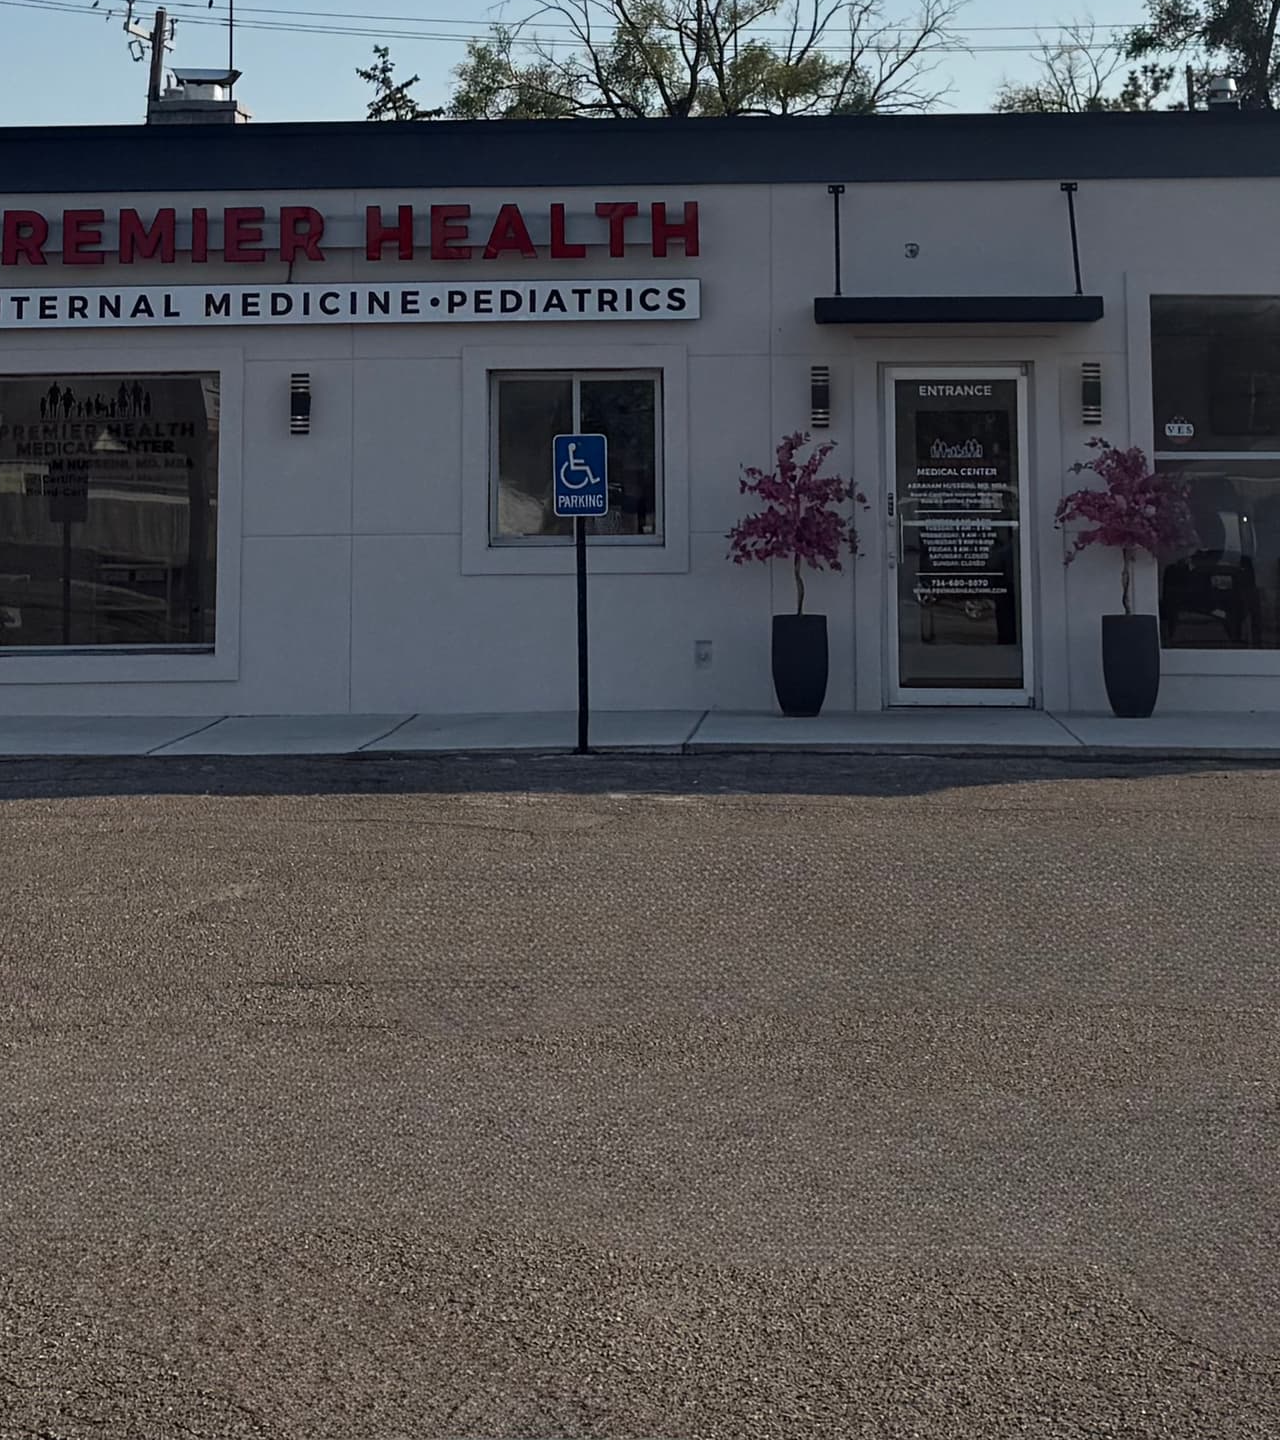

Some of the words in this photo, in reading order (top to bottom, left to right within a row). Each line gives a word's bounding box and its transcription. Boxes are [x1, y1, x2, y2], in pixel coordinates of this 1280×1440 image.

[365, 201, 700, 261] HEALTH
[918, 385, 992, 397] ENTRANCE
[106, 421, 195, 439] HEALTH
[15, 441, 97, 457] MEDICAL
[916, 467, 959, 476] MEDICAL
[960, 467, 997, 476] CENTER
[558, 493, 604, 509] PARKING
